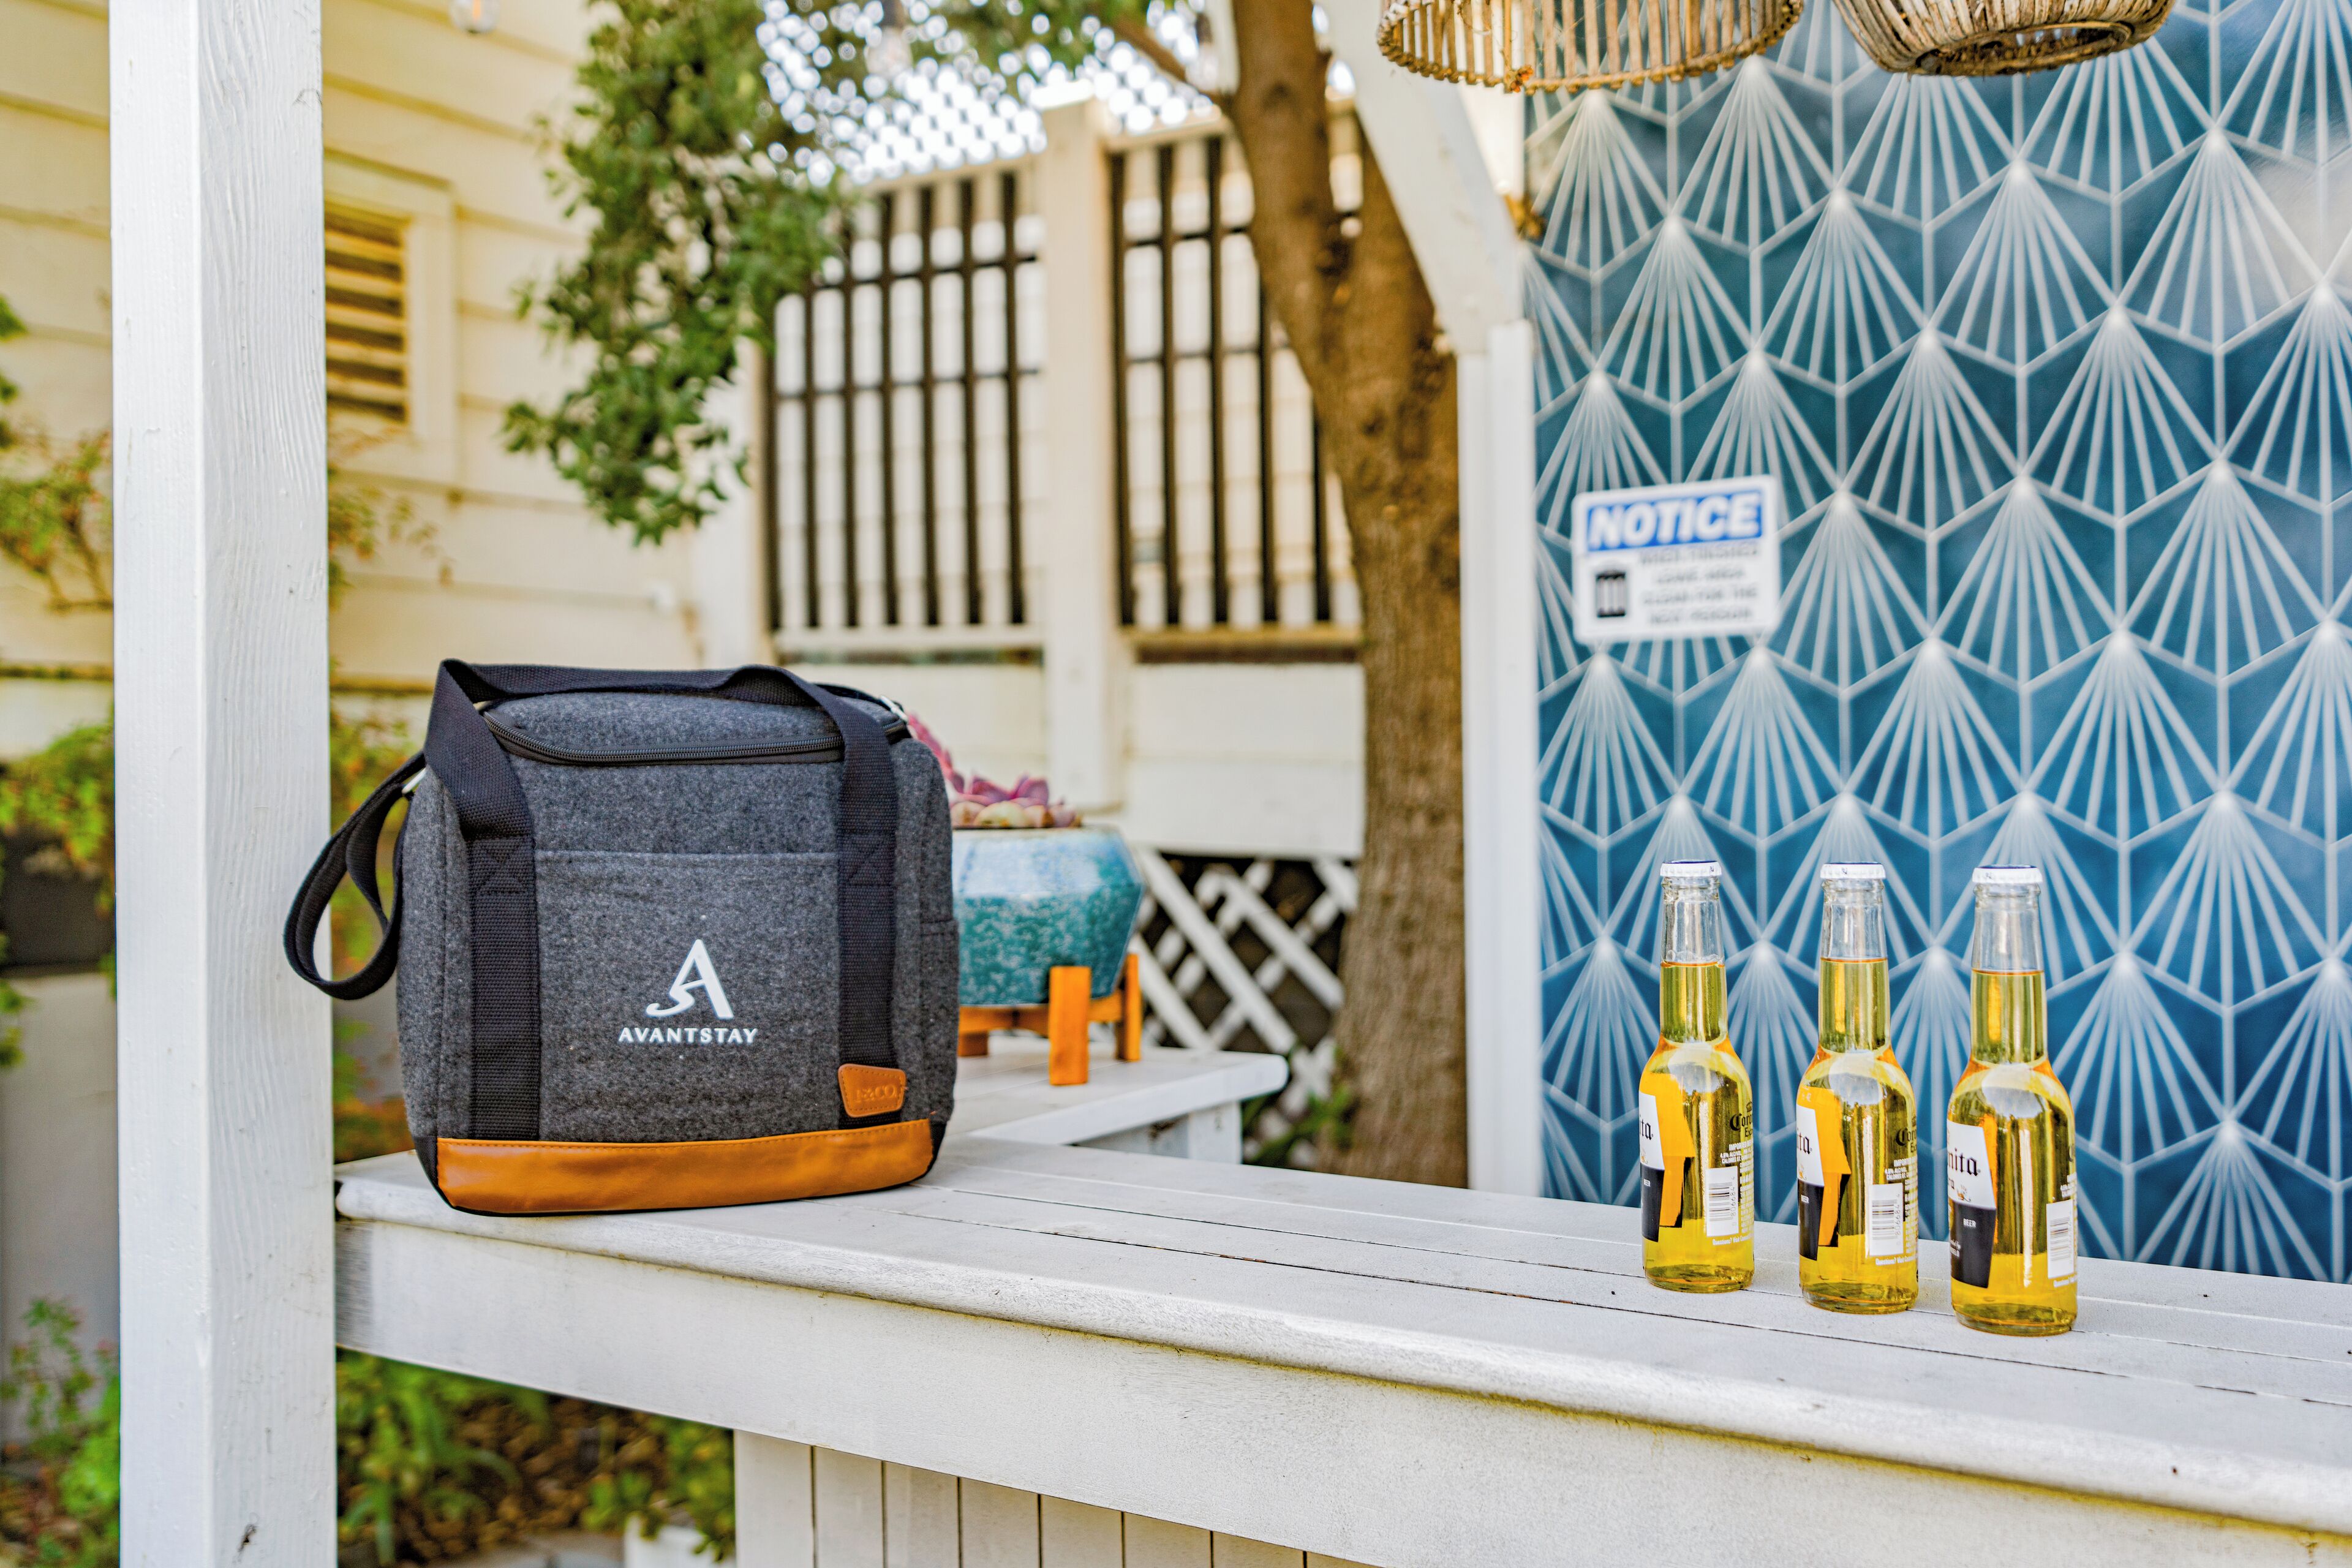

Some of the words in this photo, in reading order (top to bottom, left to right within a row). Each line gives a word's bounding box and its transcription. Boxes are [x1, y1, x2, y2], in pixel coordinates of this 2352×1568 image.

[1588, 492, 1761, 549] NOTICE
[618, 1027, 758, 1044] AVANTSTAY
[1963, 1218, 1977, 1229] BEER
